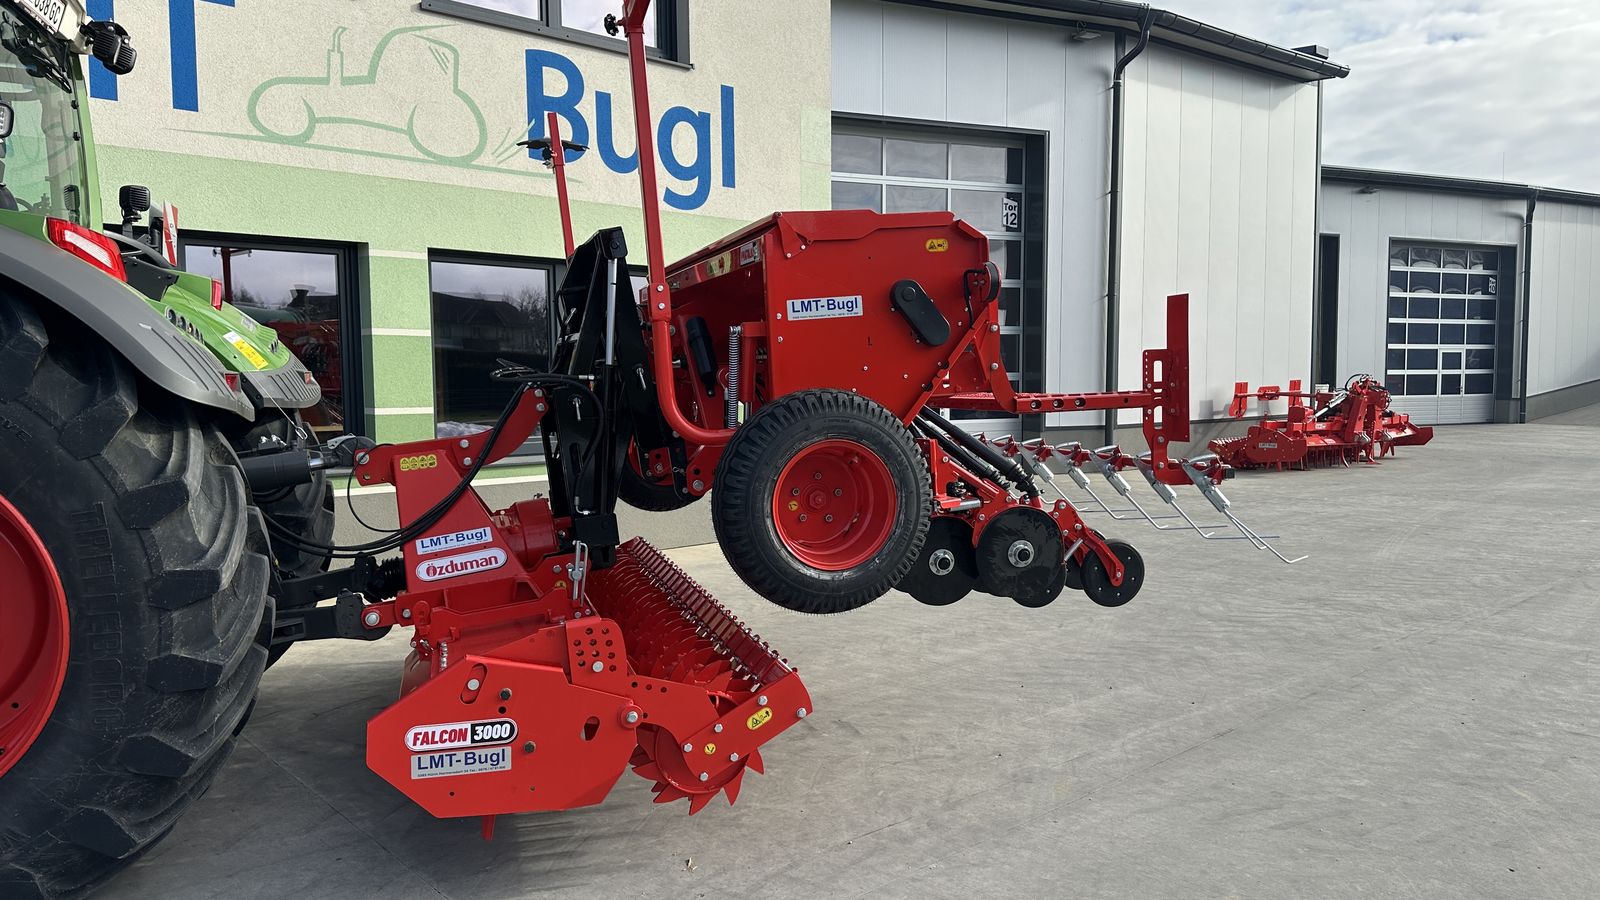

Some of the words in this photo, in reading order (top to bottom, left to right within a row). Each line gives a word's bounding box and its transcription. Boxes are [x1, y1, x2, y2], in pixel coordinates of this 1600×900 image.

[525, 48, 735, 210] Bugl
[1004, 203, 1018, 211] Tor
[1003, 212, 1017, 226] 12
[792, 297, 858, 312] LMT-Bugl
[421, 529, 487, 548] LMT-Bugl
[412, 728, 468, 746] FALCON
[474, 724, 511, 740] 3000
[418, 749, 505, 770] LMT-Bugl
